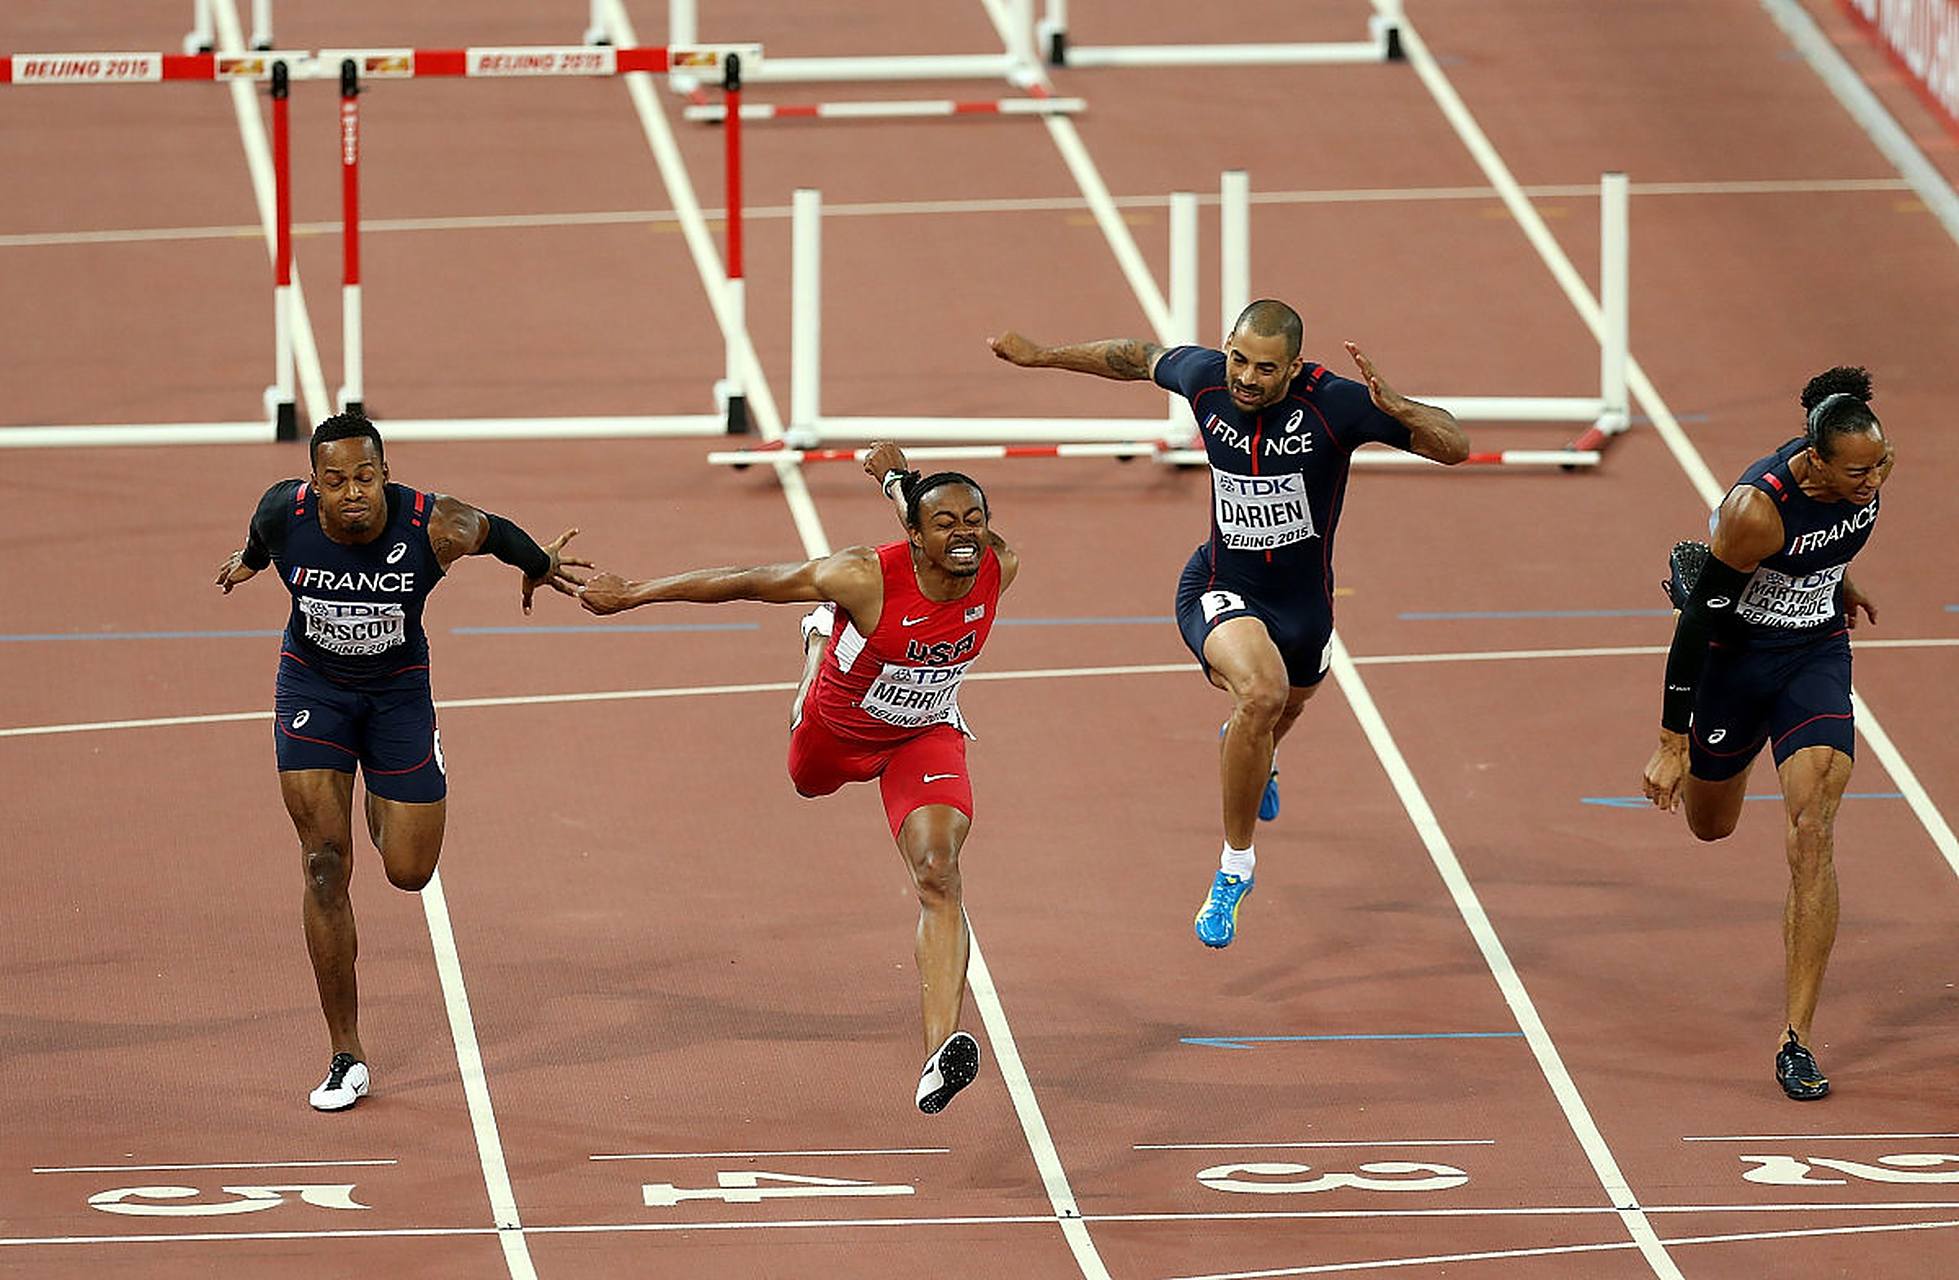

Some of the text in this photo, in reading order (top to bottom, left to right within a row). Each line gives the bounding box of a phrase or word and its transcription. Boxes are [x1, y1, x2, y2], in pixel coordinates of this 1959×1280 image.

[23, 59, 149, 77] BEIJING 2015
[1212, 419, 1313, 456] FRANCE
[1233, 477, 1297, 496] TDK
[1220, 498, 1304, 529] DARIEN
[1799, 500, 1877, 554] FRANCE
[1223, 526, 1309, 548] BEIJING 2015
[302, 568, 414, 592] FRANCE
[327, 604, 398, 618] TDK
[1213, 593, 1232, 612] 3
[907, 630, 977, 665] USA
[913, 664, 967, 685] TDK
[642, 1170, 916, 1207] 4
[1196, 1162, 1469, 1193] 3
[87, 1184, 372, 1217] 5
